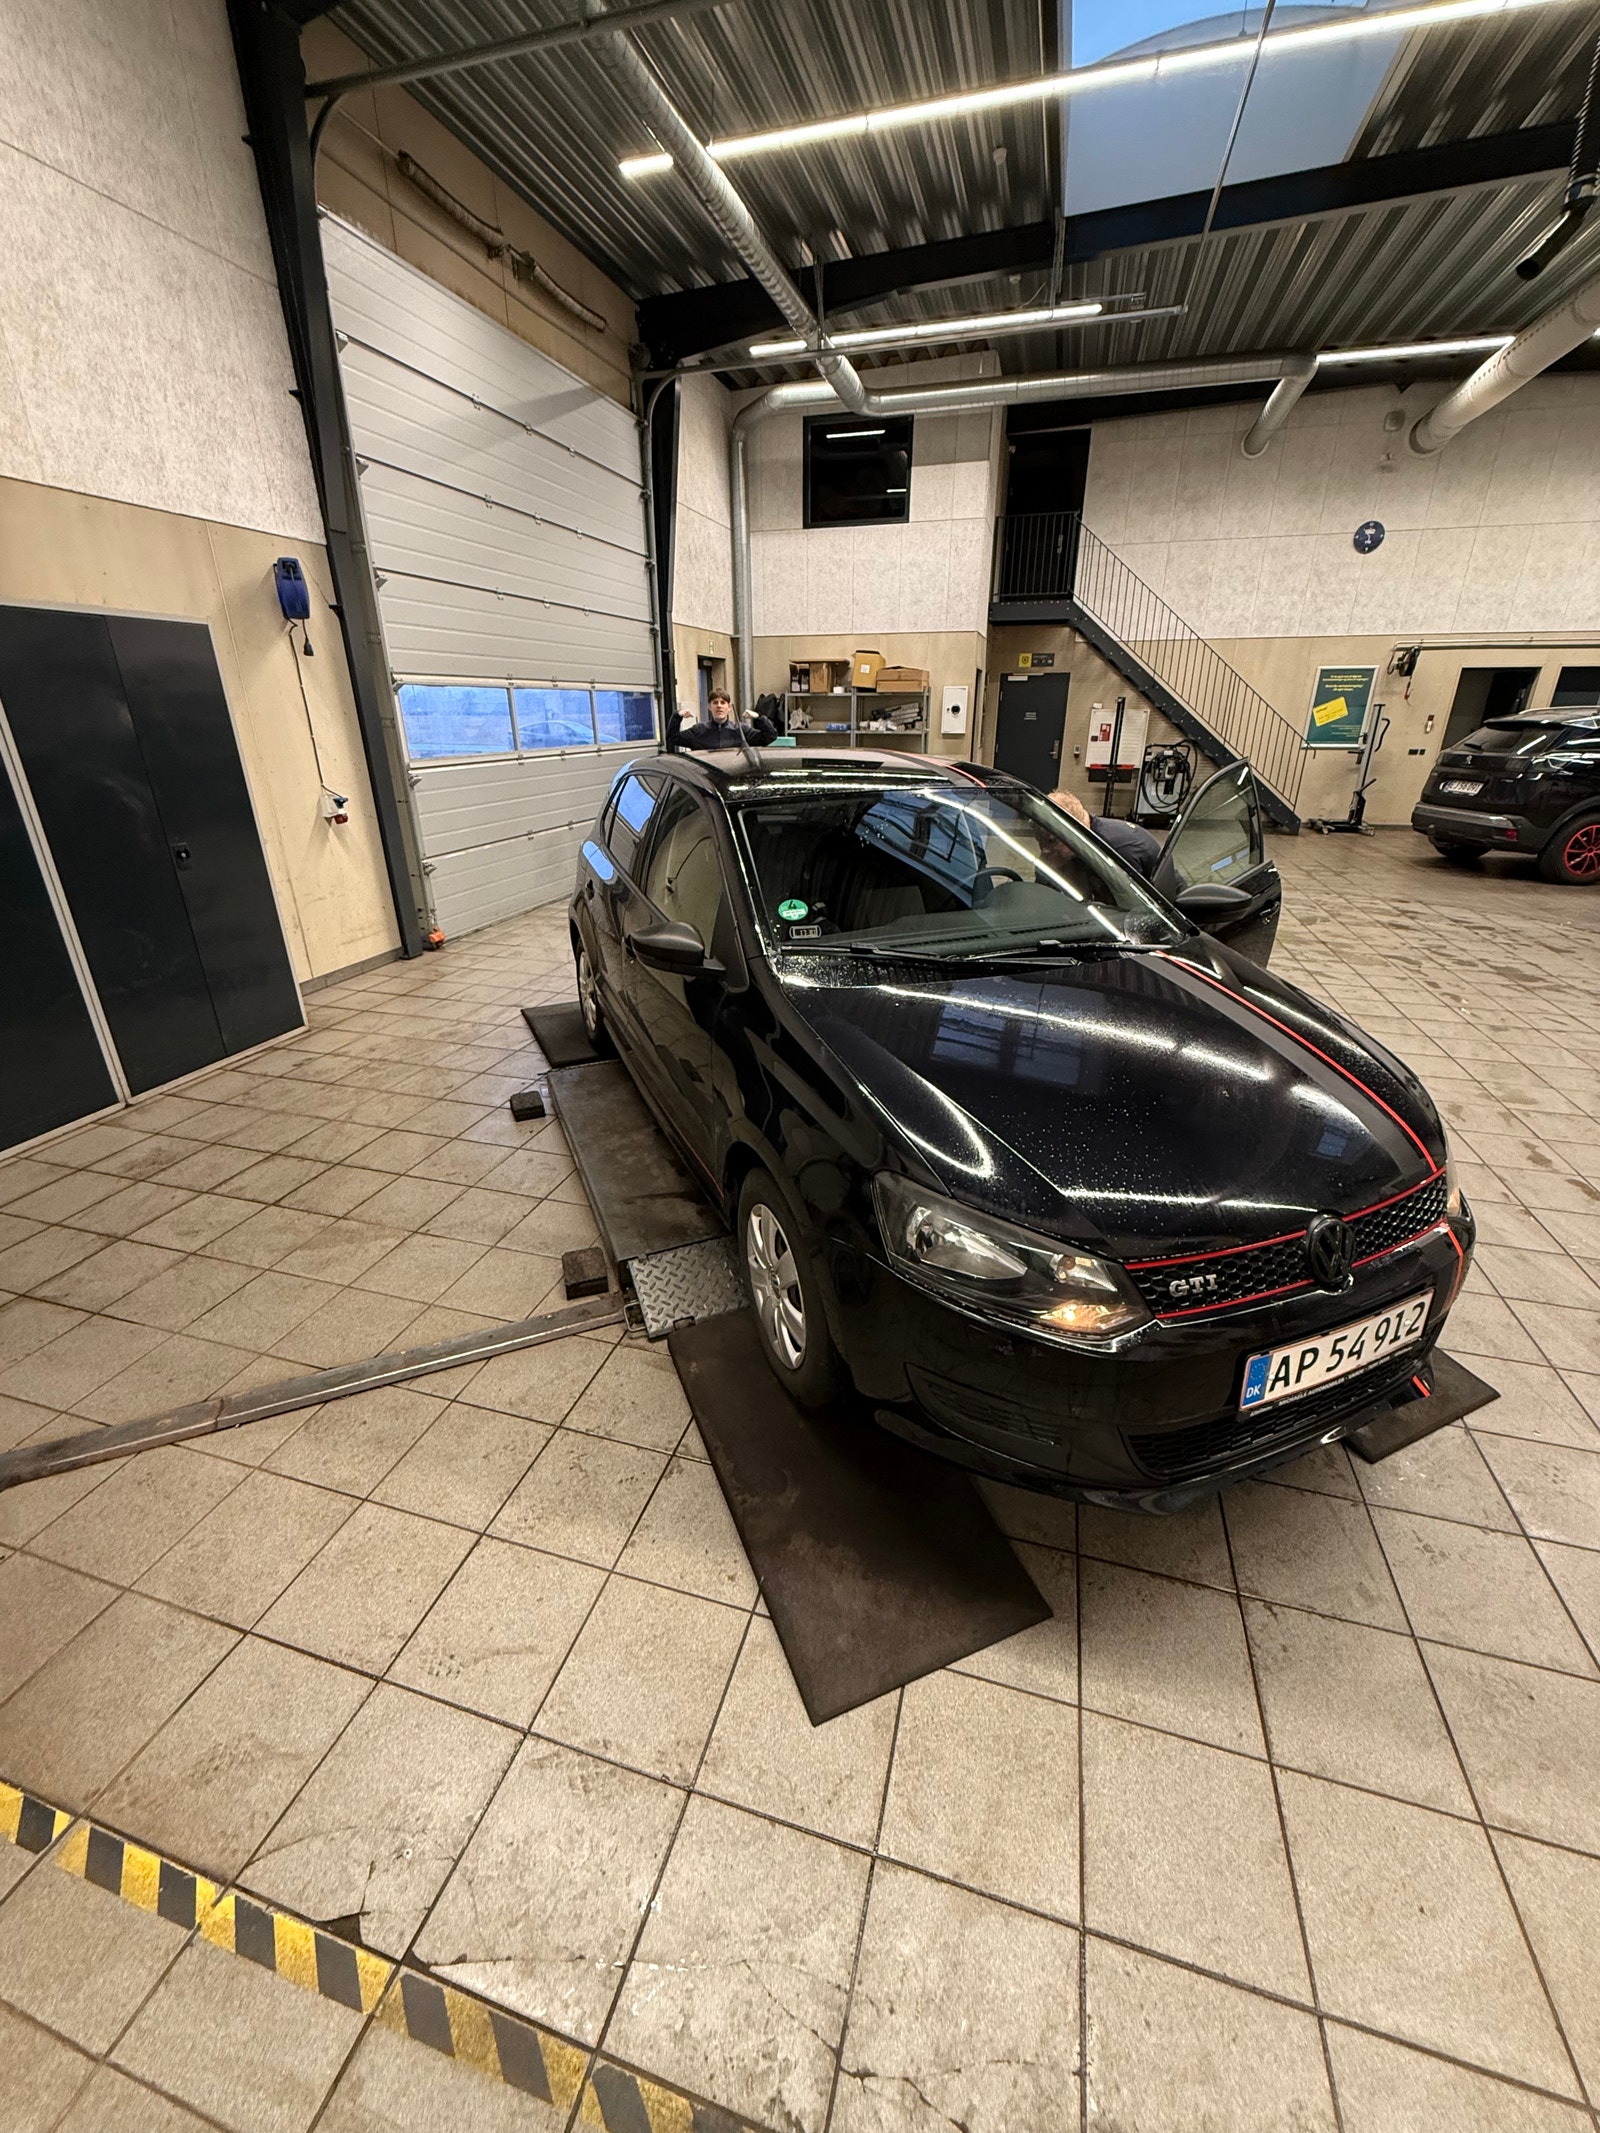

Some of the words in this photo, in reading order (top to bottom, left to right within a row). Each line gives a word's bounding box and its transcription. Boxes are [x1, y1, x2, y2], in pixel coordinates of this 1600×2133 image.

[788, 900, 797, 909] 4
[1169, 1274, 1218, 1298] GTI
[1268, 1347, 1319, 1393] AP
[1325, 1326, 1369, 1373] 54
[1374, 1301, 1426, 1353] 912
[1246, 1384, 1261, 1398] DK
